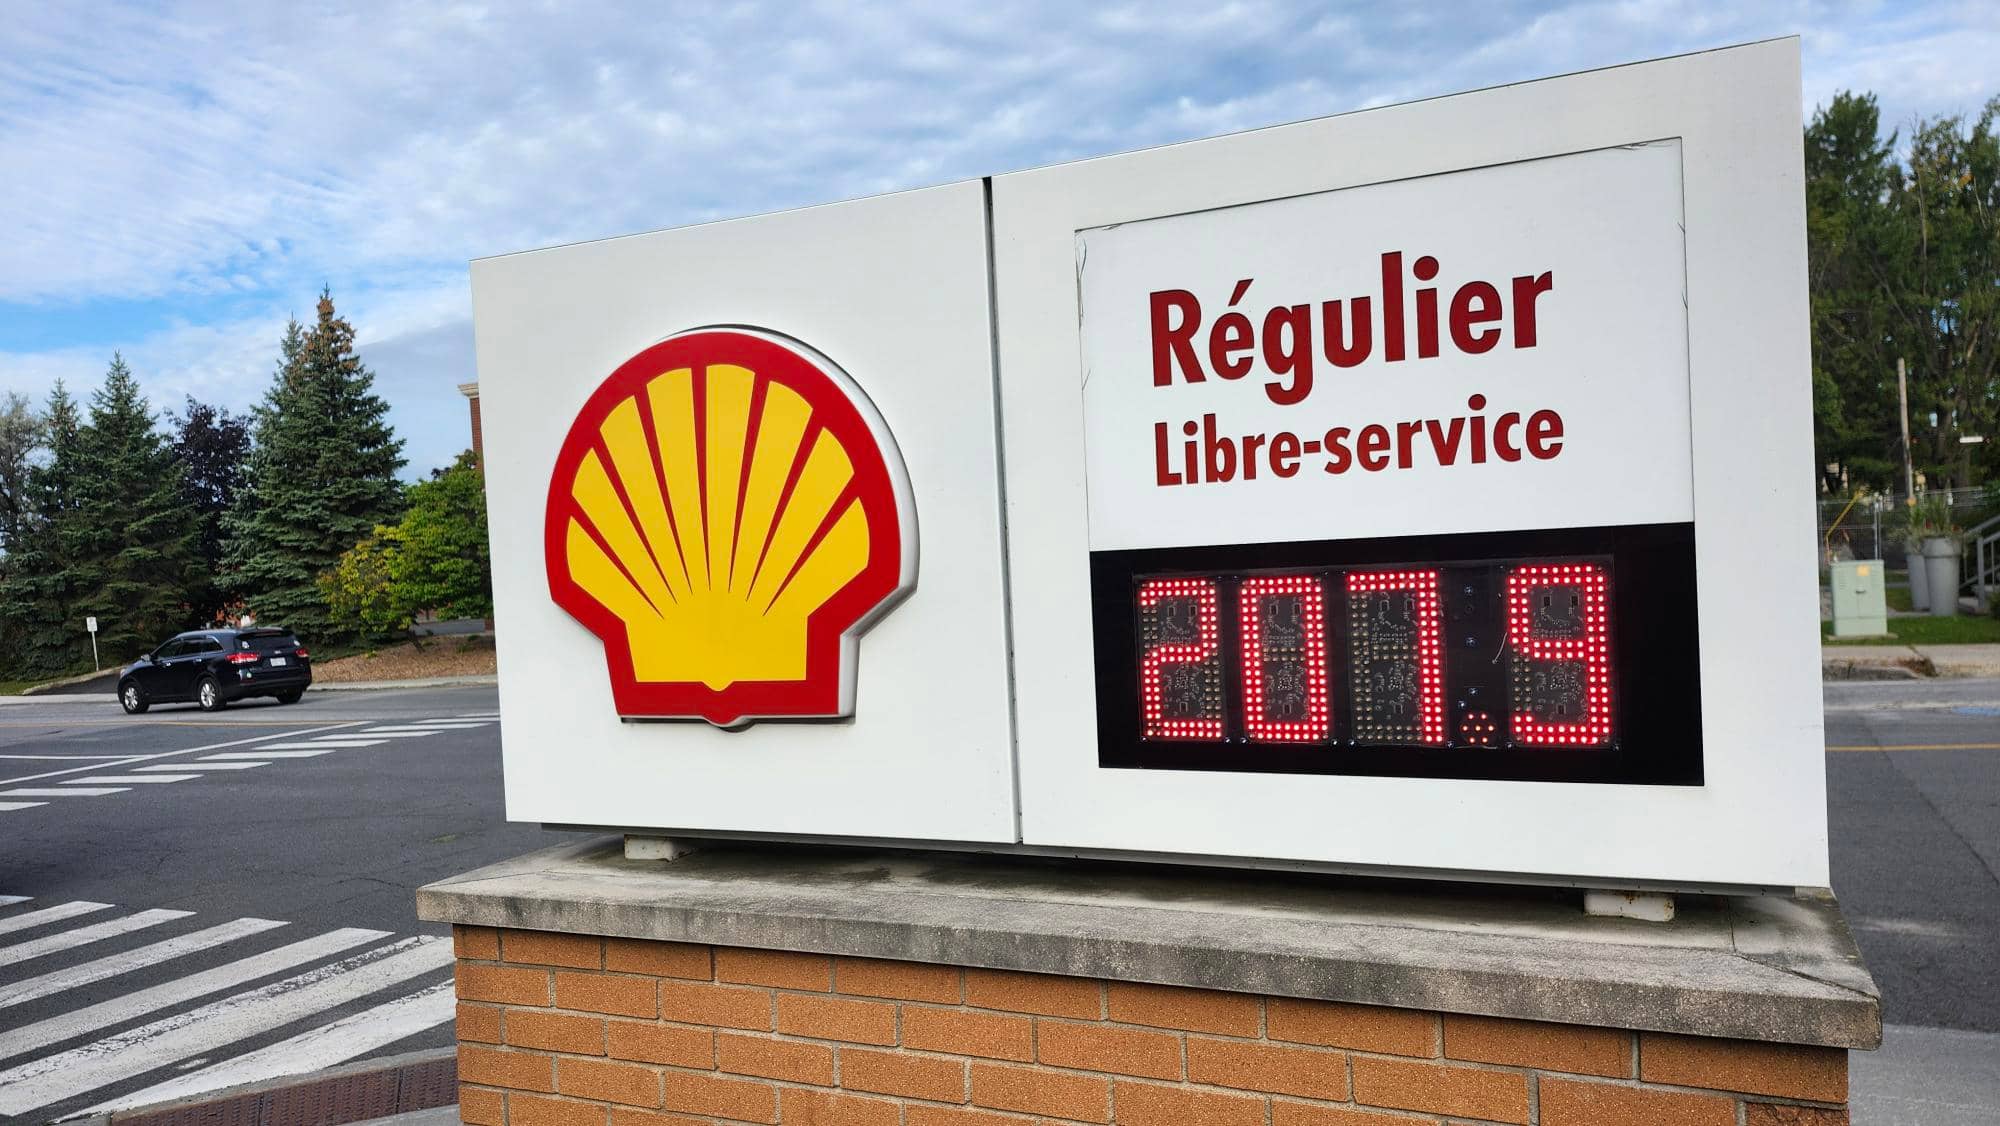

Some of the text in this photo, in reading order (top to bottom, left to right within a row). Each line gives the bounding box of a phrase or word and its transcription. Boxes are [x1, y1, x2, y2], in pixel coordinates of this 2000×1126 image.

[1150, 250, 1553, 406] Régulier
[1154, 394, 1564, 487] Libre-service
[1139, 565, 1613, 746] 207.9
